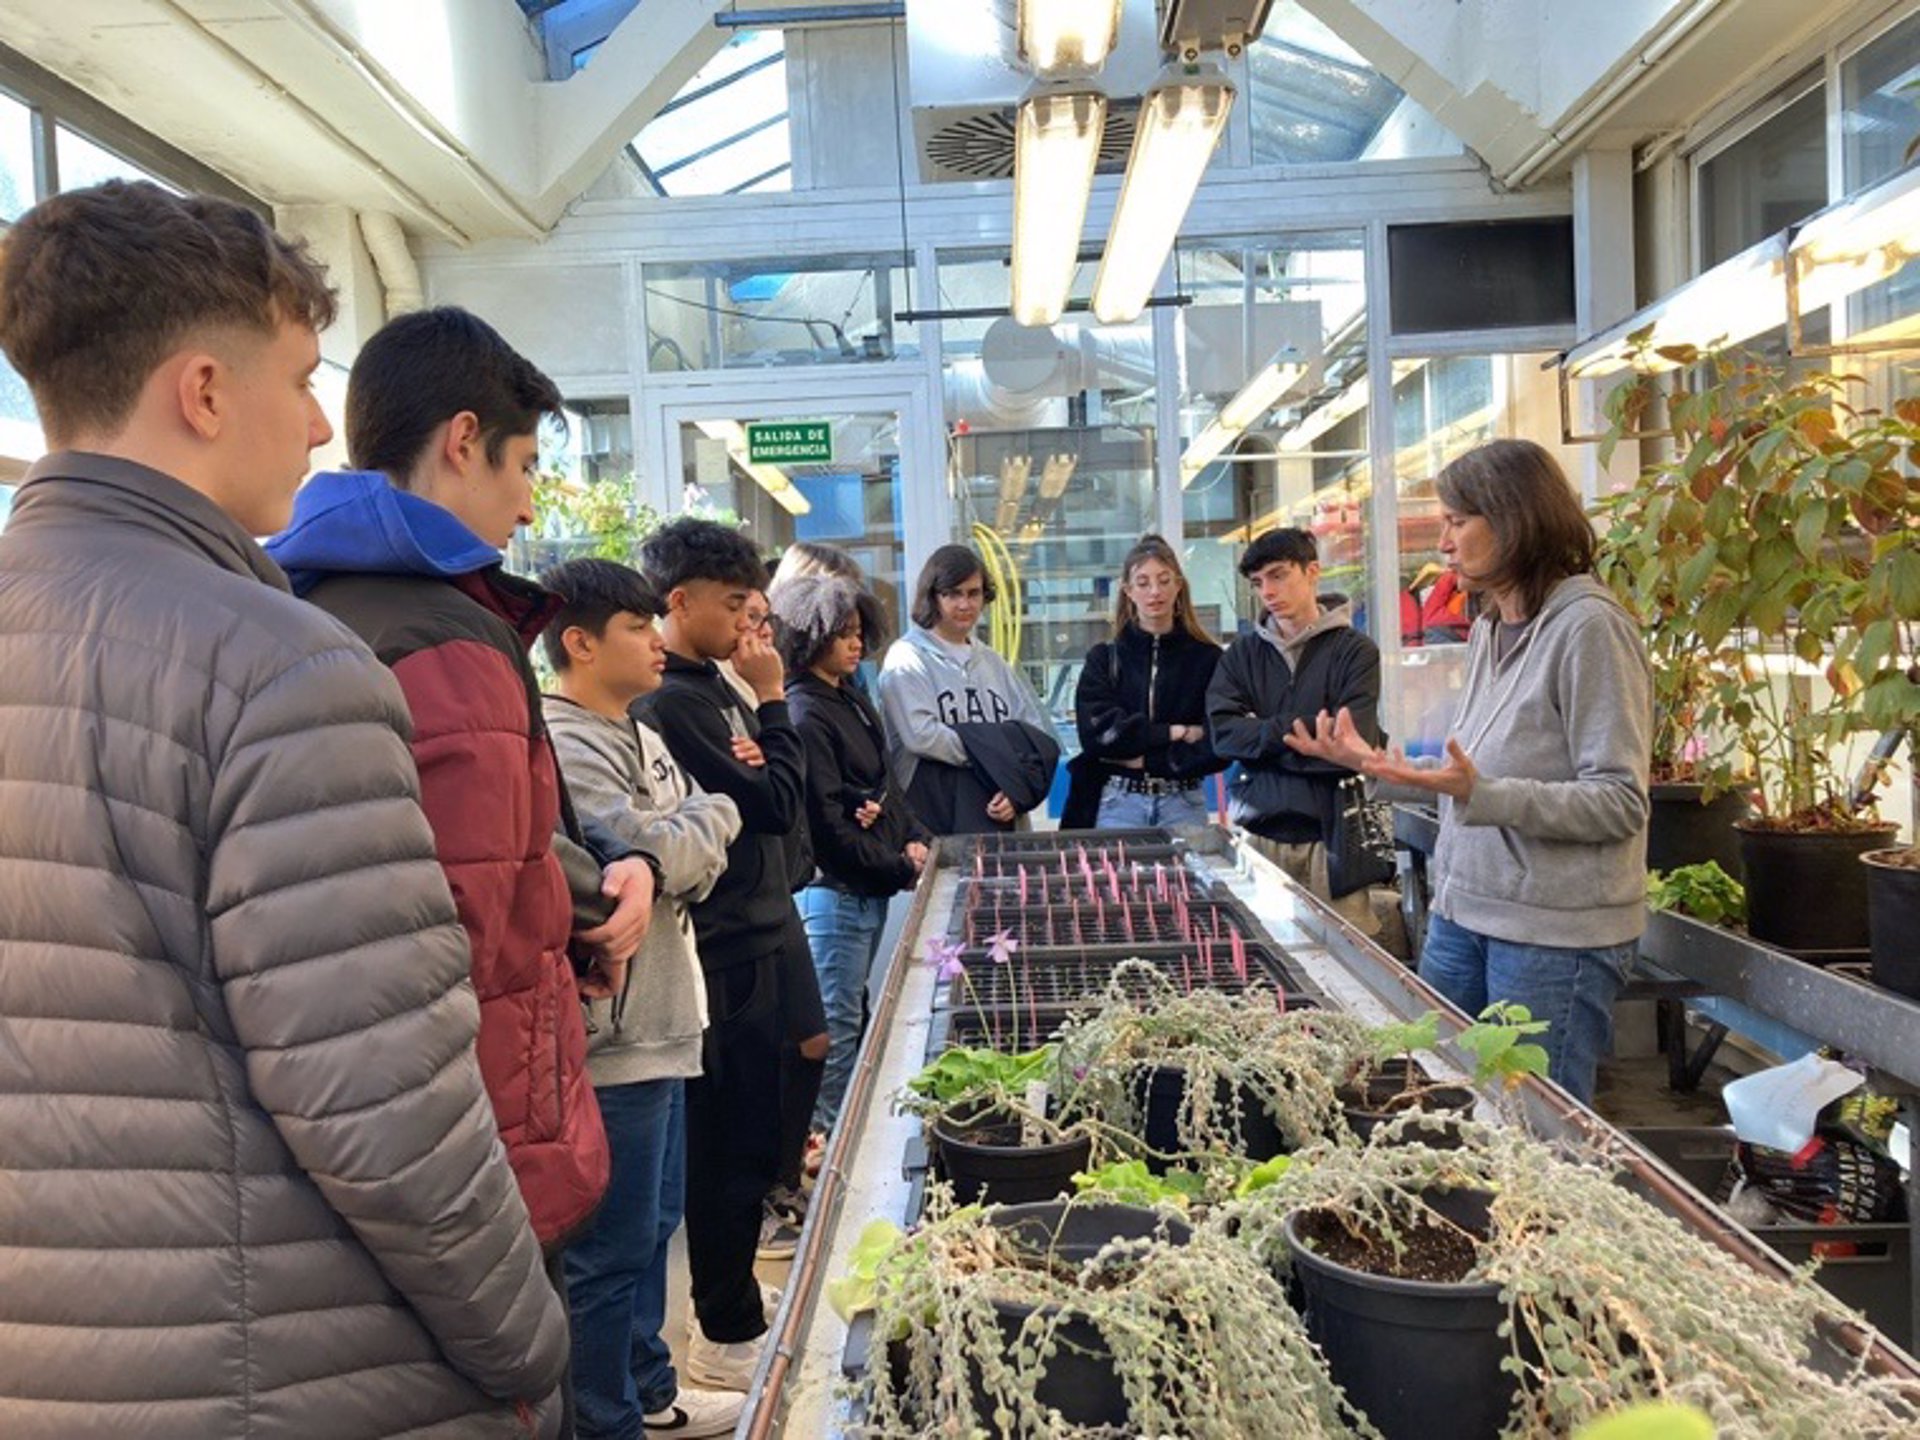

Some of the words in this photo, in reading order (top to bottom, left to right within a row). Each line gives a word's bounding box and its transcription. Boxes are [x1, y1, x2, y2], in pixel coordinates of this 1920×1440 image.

[754, 429, 802, 443] SALIDA
[807, 428, 825, 441] DE
[752, 443, 829, 458] EMERGENCIA
[937, 687, 1009, 724] GAP
